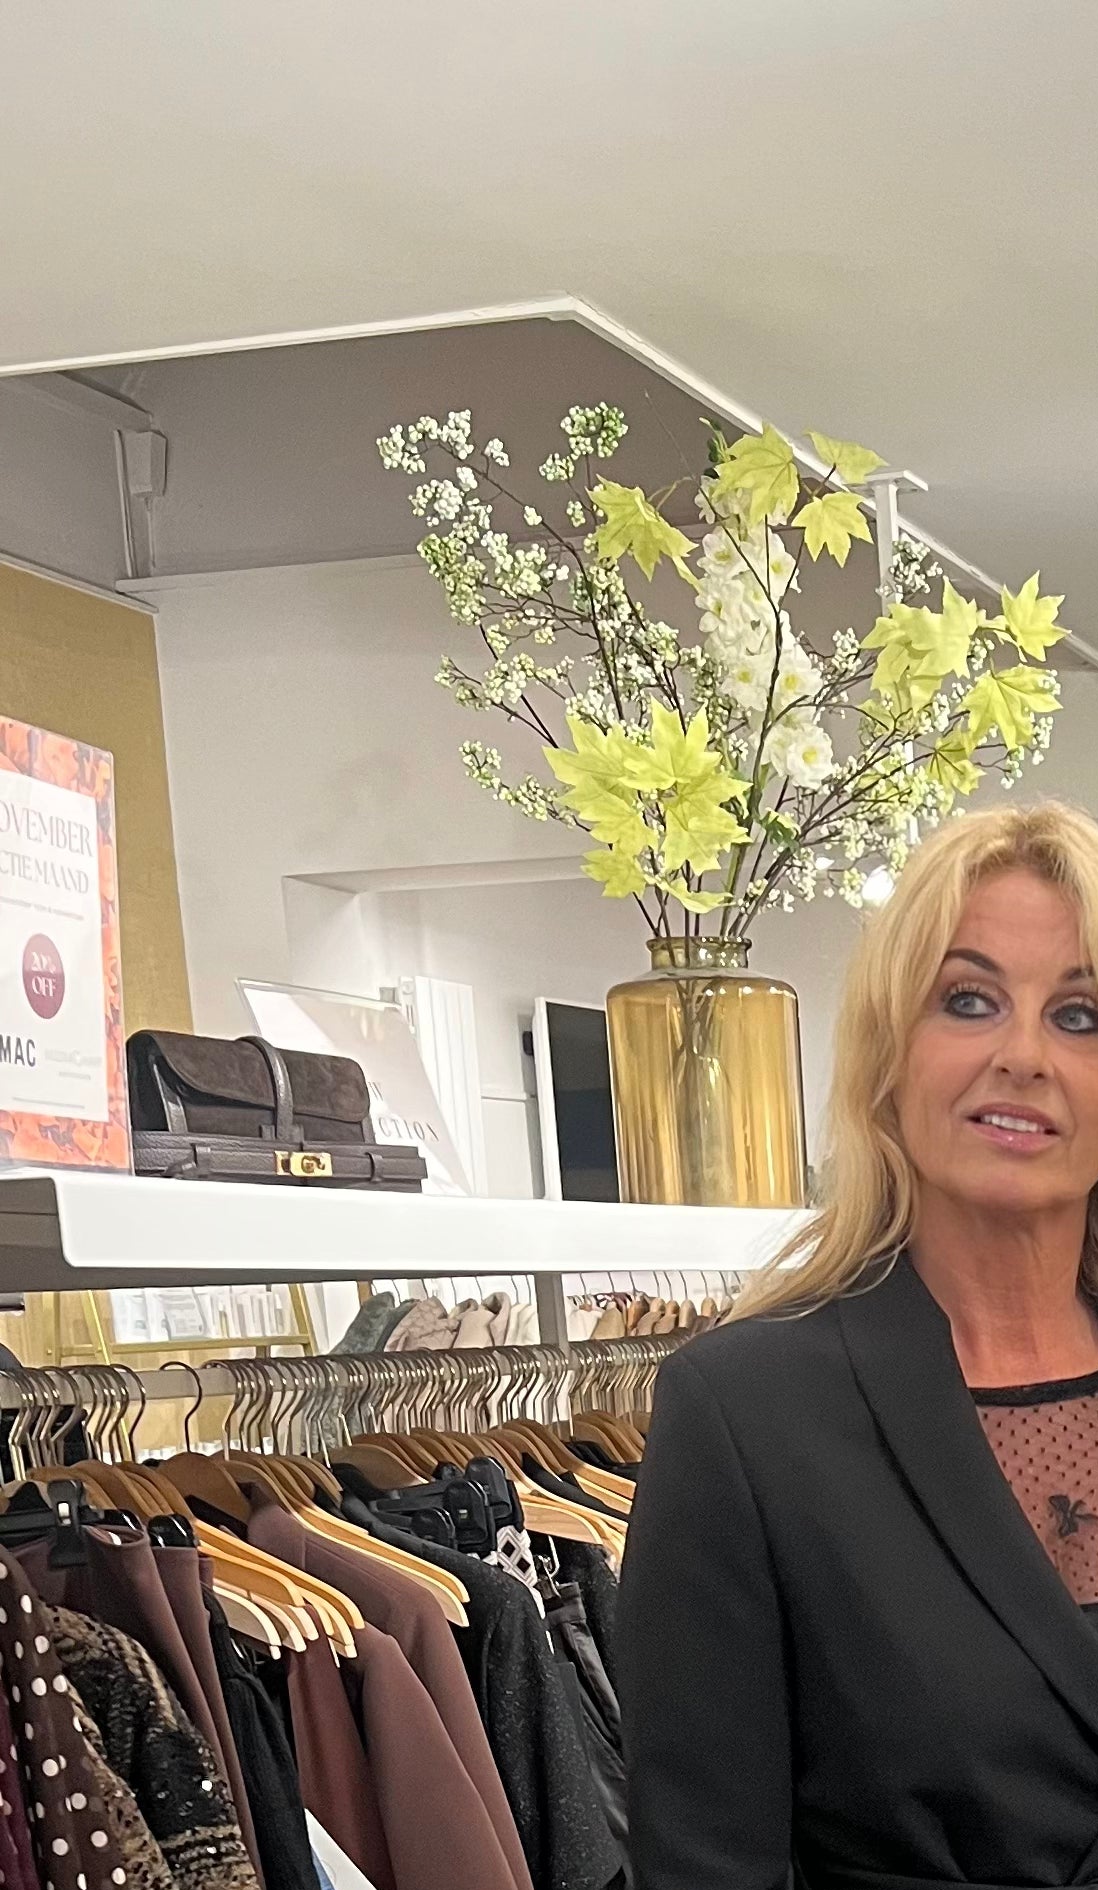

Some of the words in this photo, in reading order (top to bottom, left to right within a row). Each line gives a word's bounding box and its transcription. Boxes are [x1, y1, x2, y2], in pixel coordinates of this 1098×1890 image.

[0, 801, 93, 857] OVEMBER
[0, 849, 33, 881] CTIE
[31, 976, 57, 997] OFF
[0, 1034, 36, 1067] MAC
[378, 1116, 439, 1142] CTION
